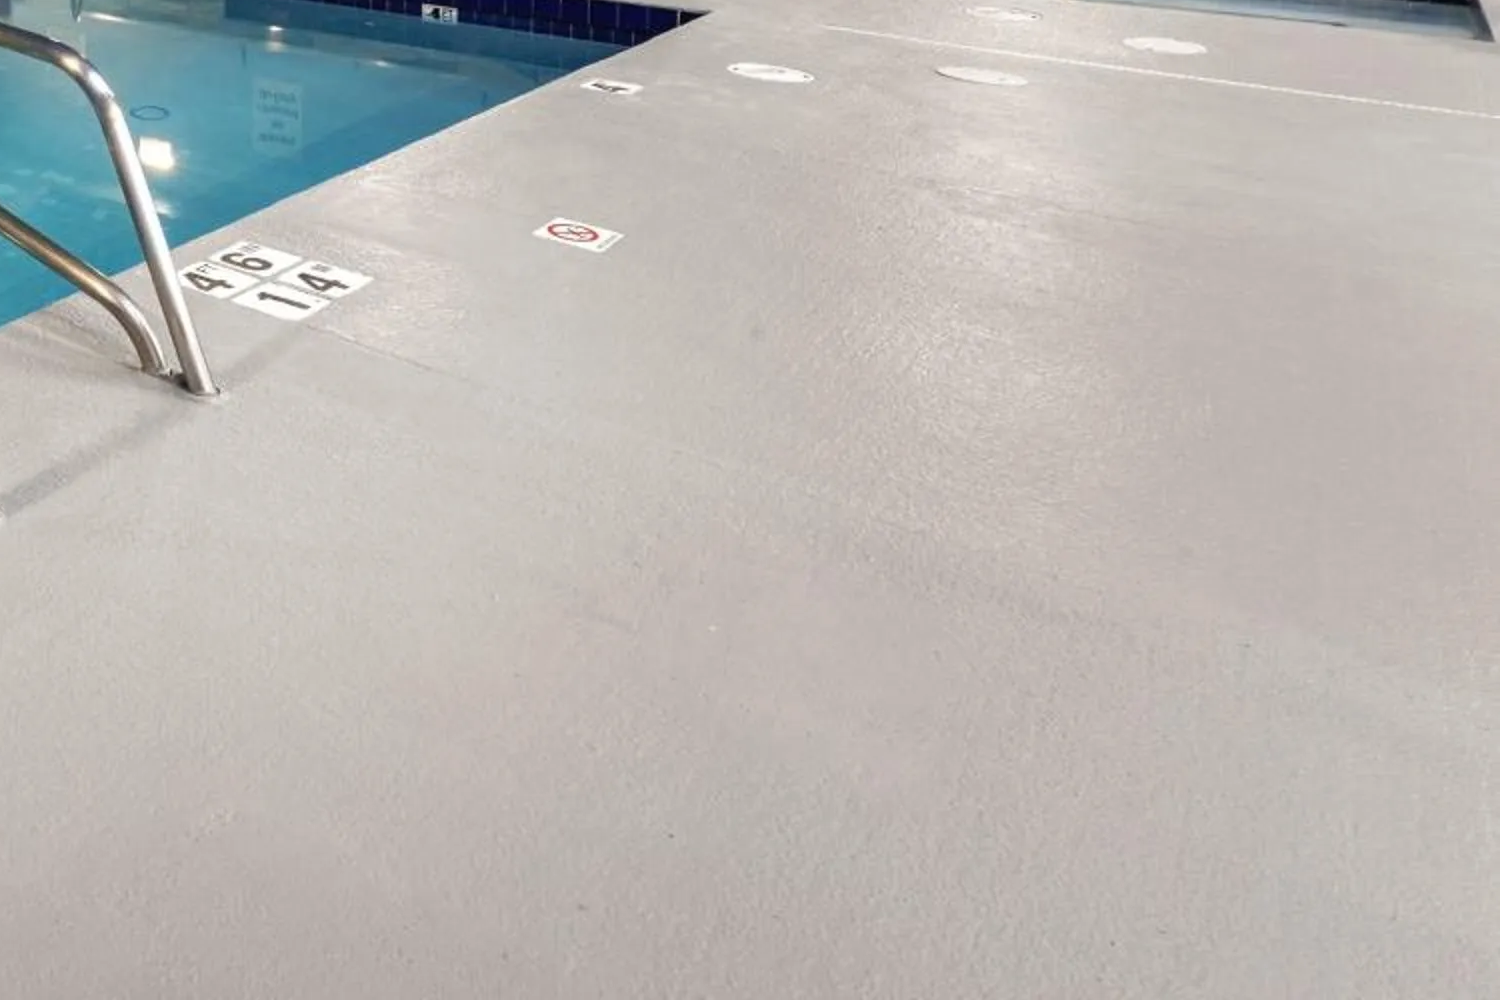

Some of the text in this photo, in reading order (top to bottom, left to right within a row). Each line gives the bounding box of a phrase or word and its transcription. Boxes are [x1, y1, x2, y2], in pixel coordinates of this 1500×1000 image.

[184, 271, 236, 293] 4
[220, 253, 274, 272] 6
[297, 272, 350, 293] 4
